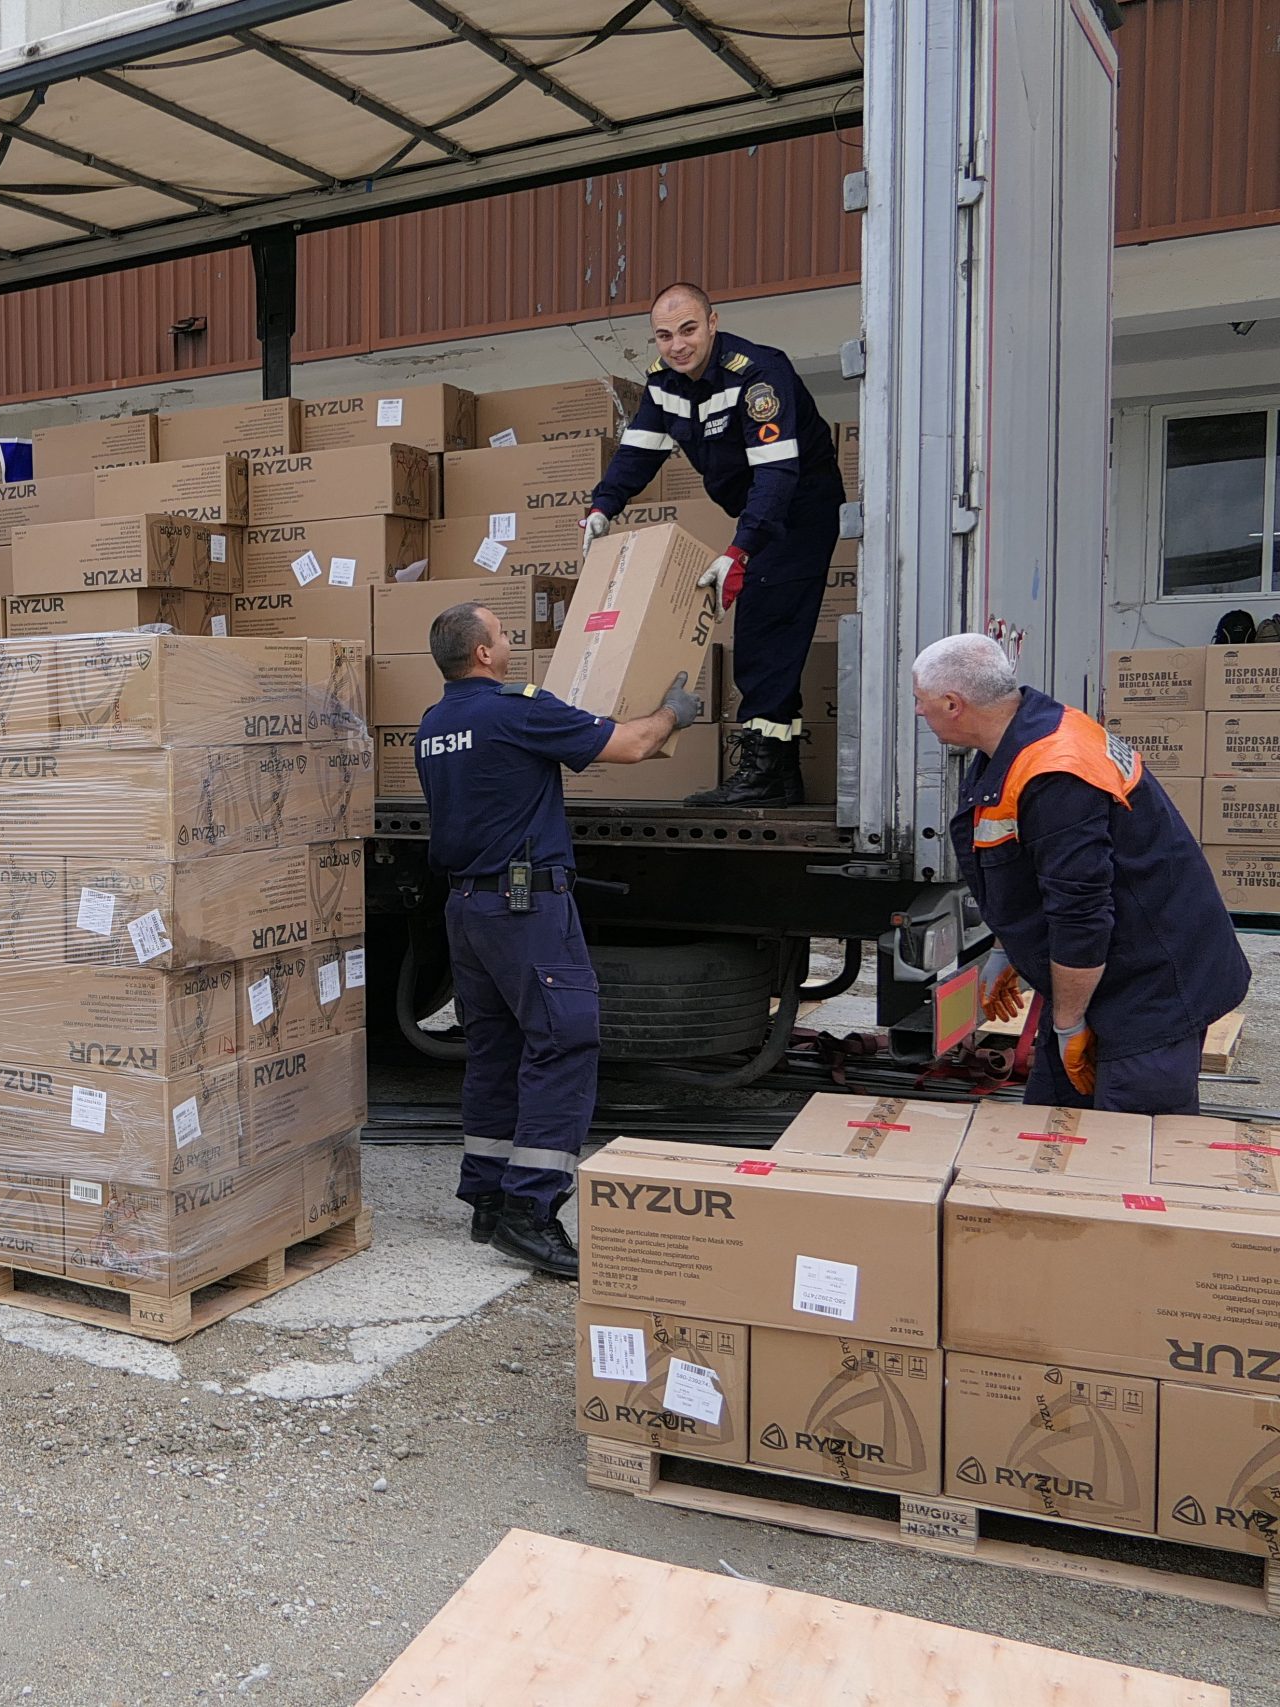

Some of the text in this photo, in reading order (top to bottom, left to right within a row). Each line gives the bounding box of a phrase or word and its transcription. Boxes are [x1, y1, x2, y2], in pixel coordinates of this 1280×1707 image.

[305, 398, 364, 418] RYZUR
[253, 456, 312, 477] RYZUR
[247, 526, 306, 545] RYZUR
[510, 559, 578, 577] RYZUR
[83, 568, 143, 587] RYZUR
[9, 597, 65, 615] RYZUR
[234, 593, 293, 612] RYZUR
[691, 593, 717, 647] ZUR
[1119, 672, 1178, 682] DISPOSABLE
[1119, 679, 1193, 689] MEDICAL FACE MASK
[1225, 676, 1280, 685] MEDICAL FACE
[244, 713, 303, 737] RYZUR
[320, 712, 351, 726] RYZUR
[420, 730, 473, 759] ПБЗН
[1119, 735, 1169, 745] SPOSABLE
[1141, 743, 1184, 752] FACE MASK
[1226, 736, 1280, 746] DISPOSAB
[1226, 745, 1280, 753] MEDICAL FACE
[328, 754, 360, 768] RYZUR
[1222, 811, 1278, 820] MEDICAL FACE
[1223, 802, 1280, 813] DISPOSABL
[319, 853, 349, 868] RYZUR
[1222, 869, 1244, 877] MASK
[252, 920, 308, 950] RYZUR
[70, 1040, 158, 1069] RYZUR
[254, 1053, 306, 1088] RYZUR
[174, 1175, 235, 1217] RYZUR
[590, 1179, 736, 1220] RYZUR
[320, 1195, 348, 1217] RYZUR
[591, 1225, 625, 1235] Disposable
[626, 1229, 659, 1239] particulate
[660, 1233, 691, 1243] respirator
[692, 1235, 706, 1243] Face
[726, 1239, 744, 1247] KN95
[634, 1239, 666, 1249] particules
[666, 1242, 689, 1251] jetable
[627, 1247, 700, 1260] particolato respiratorio
[663, 1270, 677, 1278] part
[1212, 1272, 1233, 1281] culas
[1242, 1275, 1260, 1284] part
[1195, 1281, 1218, 1290] KN95
[1212, 1293, 1260, 1305] respiratorio
[1156, 1308, 1263, 1326] respirator Face Mask KN95
[1225, 1305, 1280, 1318] icules jetable
[676, 1372, 711, 1388] 580-239274
[616, 1404, 698, 1435] RYZUR
[795, 1431, 886, 1464] RYZUR
[995, 1466, 1095, 1501] RYZUR
